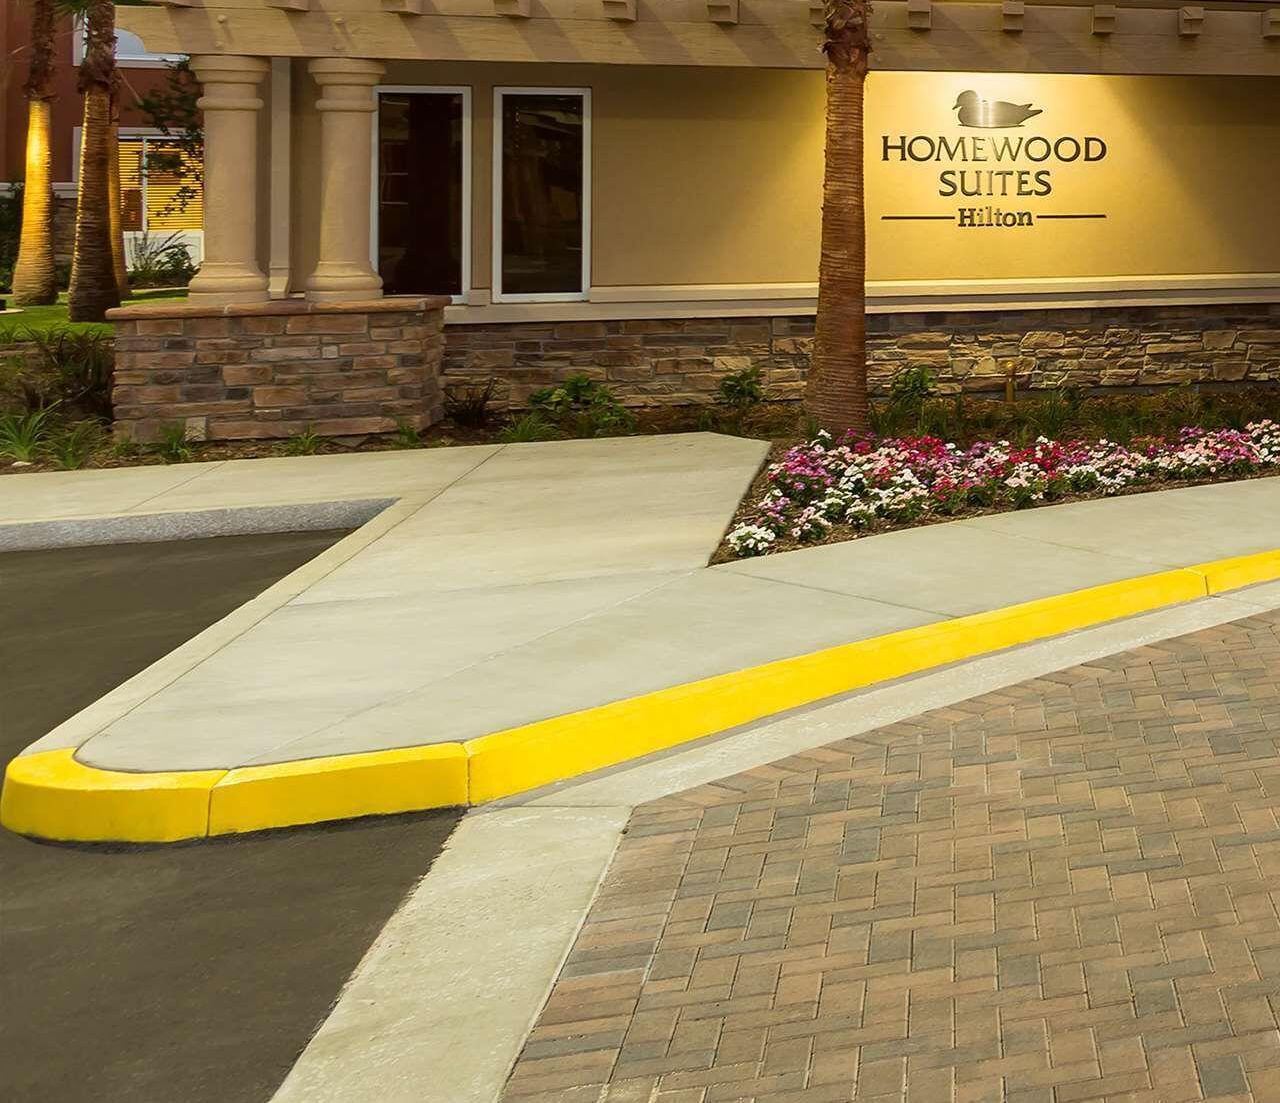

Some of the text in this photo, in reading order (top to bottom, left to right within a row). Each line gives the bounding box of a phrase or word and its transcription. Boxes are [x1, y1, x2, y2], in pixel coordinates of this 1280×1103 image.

[881, 135, 1107, 162] HOMEWOOD
[939, 170, 1052, 196] SUITES
[958, 206, 1033, 227] Hilton
